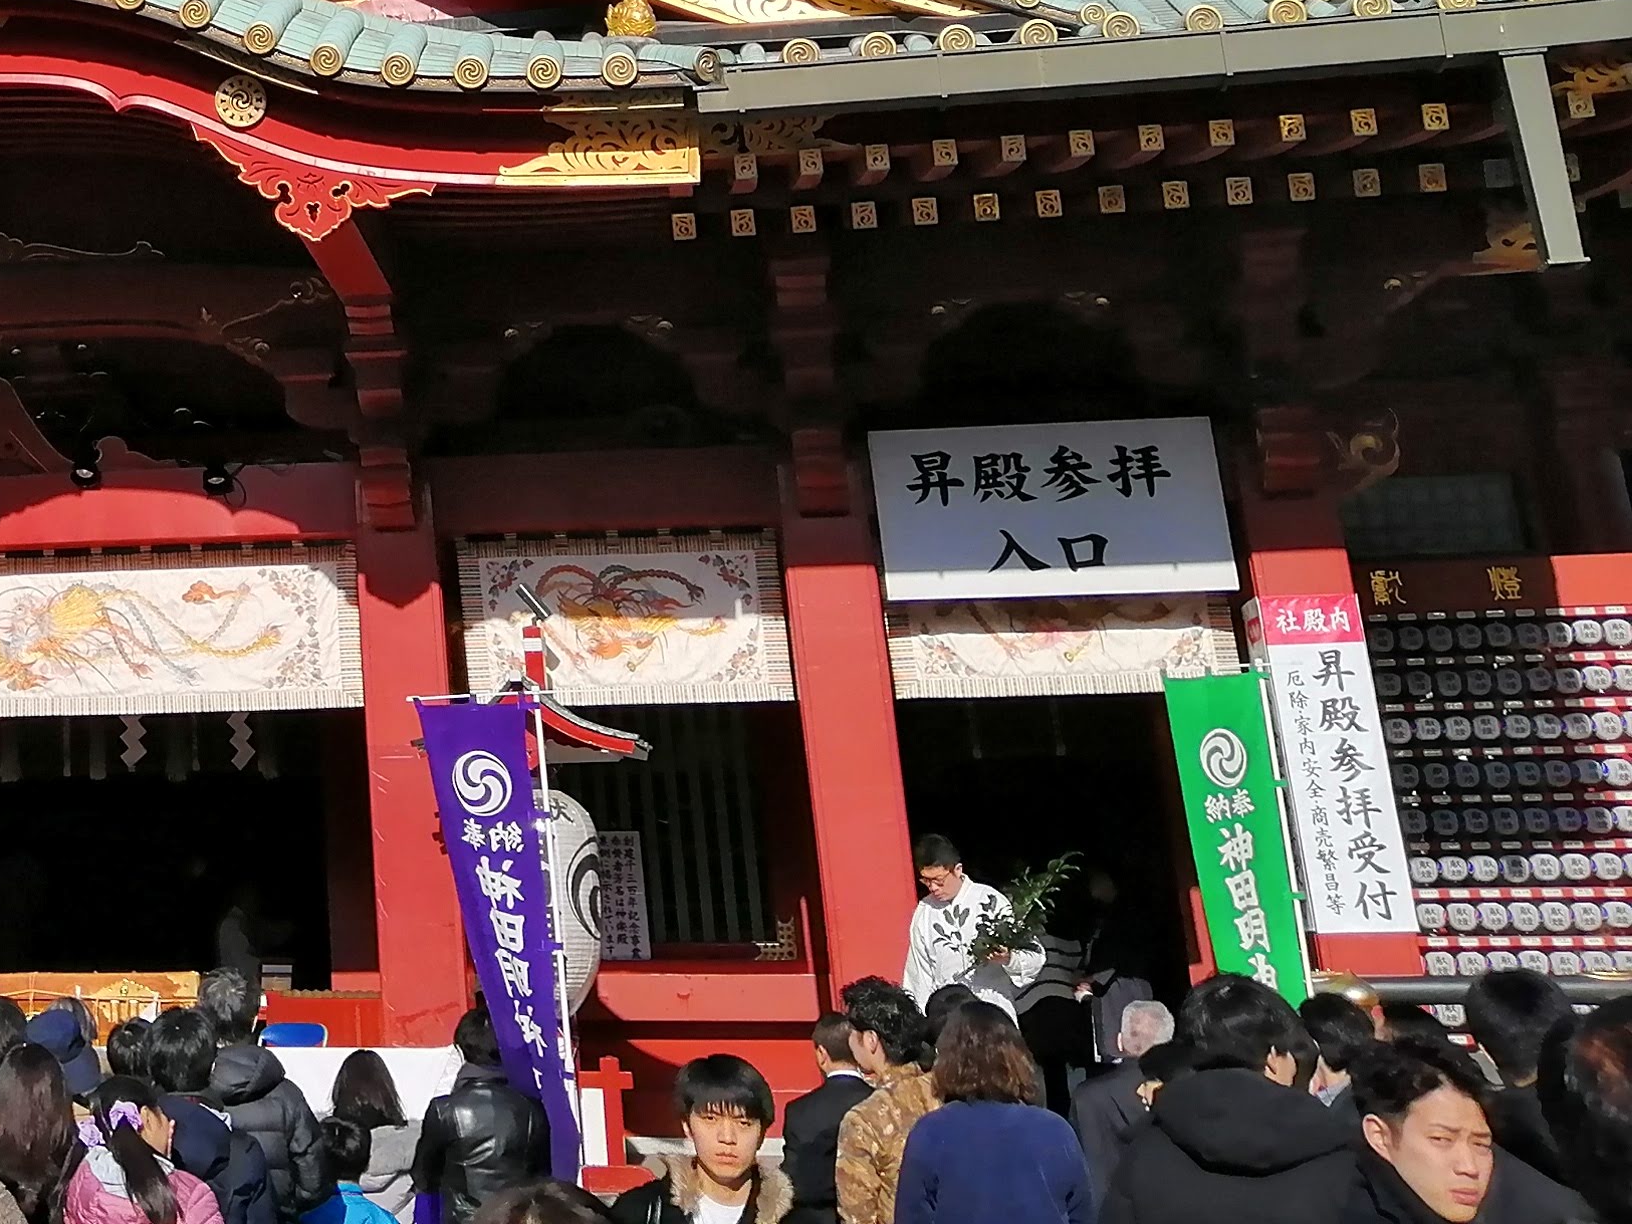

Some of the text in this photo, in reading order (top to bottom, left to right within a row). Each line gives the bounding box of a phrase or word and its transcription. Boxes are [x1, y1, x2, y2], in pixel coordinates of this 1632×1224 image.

[906, 445, 1172, 506] 昇殿参拝
[988, 528, 1109, 573] 入口
[1276, 603, 1351, 634] 社殿内
[1312, 650, 1398, 921] 昇殿参拝受付
